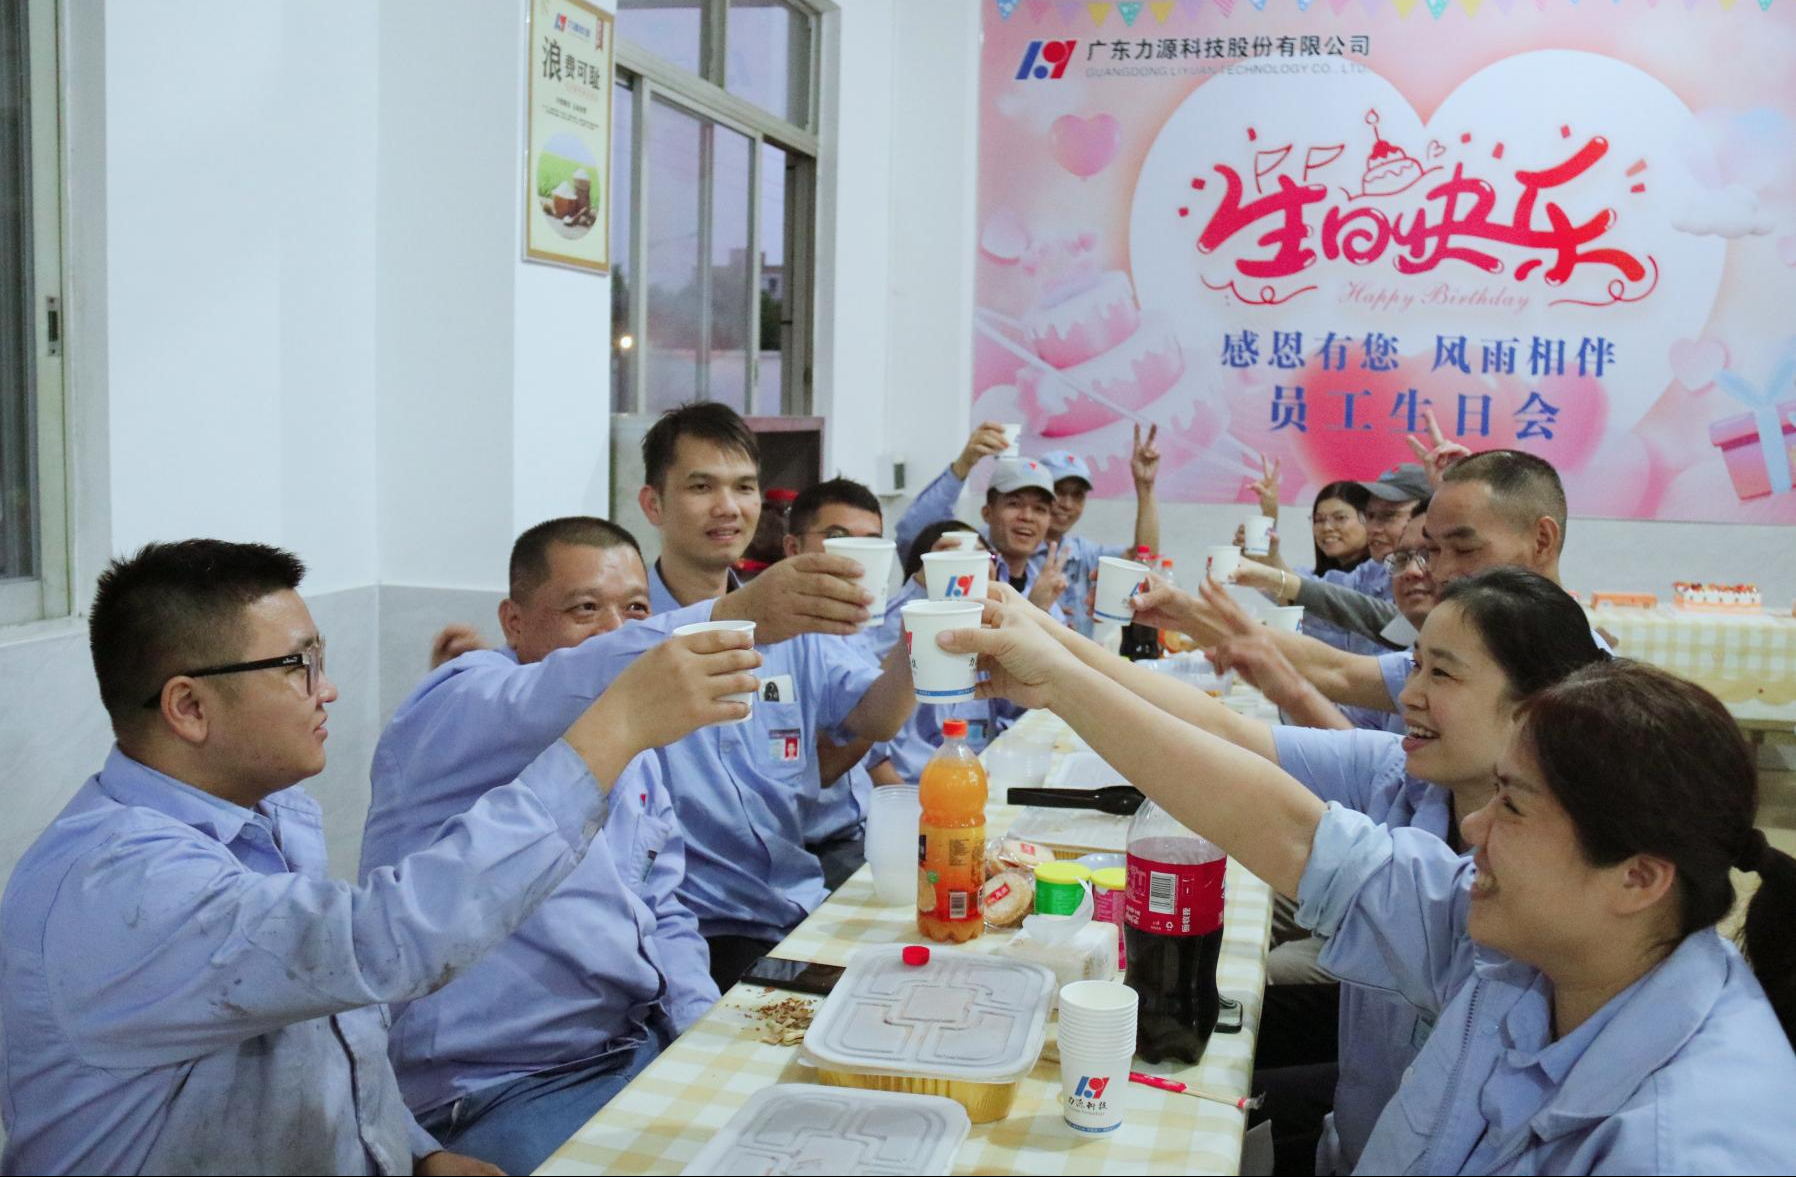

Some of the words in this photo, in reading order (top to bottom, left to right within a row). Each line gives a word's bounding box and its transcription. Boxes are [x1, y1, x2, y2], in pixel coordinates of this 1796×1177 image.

[1087, 35, 1370, 61] 广东力源科技股份有限公司
[1085, 66, 1169, 78] GUANGDONG
[1170, 65, 1217, 76] LIYUAN
[1220, 63, 1308, 75] TECHNOLOGY
[1198, 136, 1646, 286] 生日快乐
[1338, 281, 1414, 315] Happy
[1420, 283, 1529, 315] Birthday
[1221, 329, 1399, 373] 感恩有您
[1432, 334, 1617, 378] 风雨相伴
[1269, 384, 1561, 440] 员工生日会
